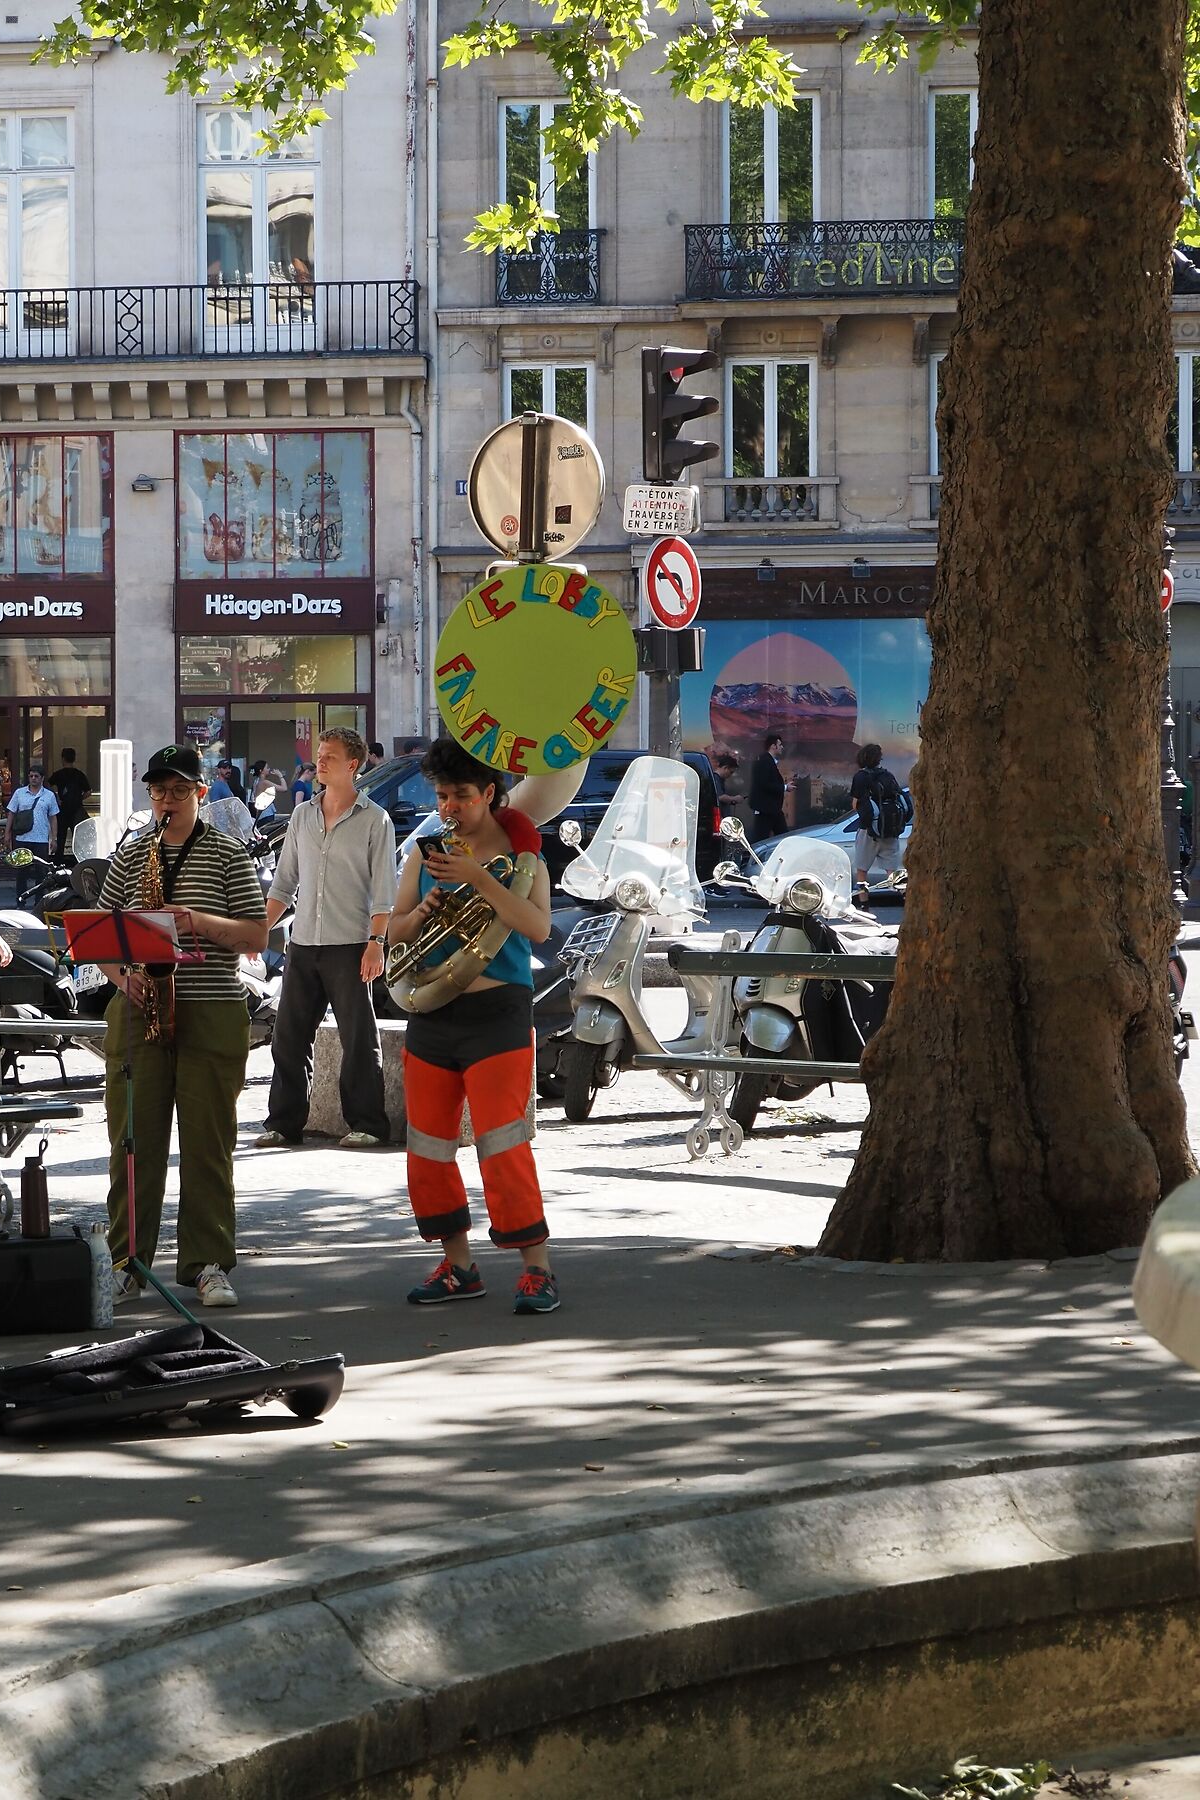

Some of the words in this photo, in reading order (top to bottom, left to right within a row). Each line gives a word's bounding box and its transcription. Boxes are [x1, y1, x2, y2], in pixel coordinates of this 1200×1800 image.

[629, 510, 686, 521] TRAVERSEZ
[628, 520, 640, 529] EN
[643, 520, 649, 529] 2
[653, 521, 686, 530] TEMPS
[466, 579, 517, 629] LE
[521, 568, 620, 628] LOBBY
[205, 593, 342, 621] Häagen-Dazs
[436, 653, 538, 774] FANFARE
[543, 667, 635, 769] QUEER
[888, 719, 918, 734] Terr
[82, 965, 93, 976] FG
